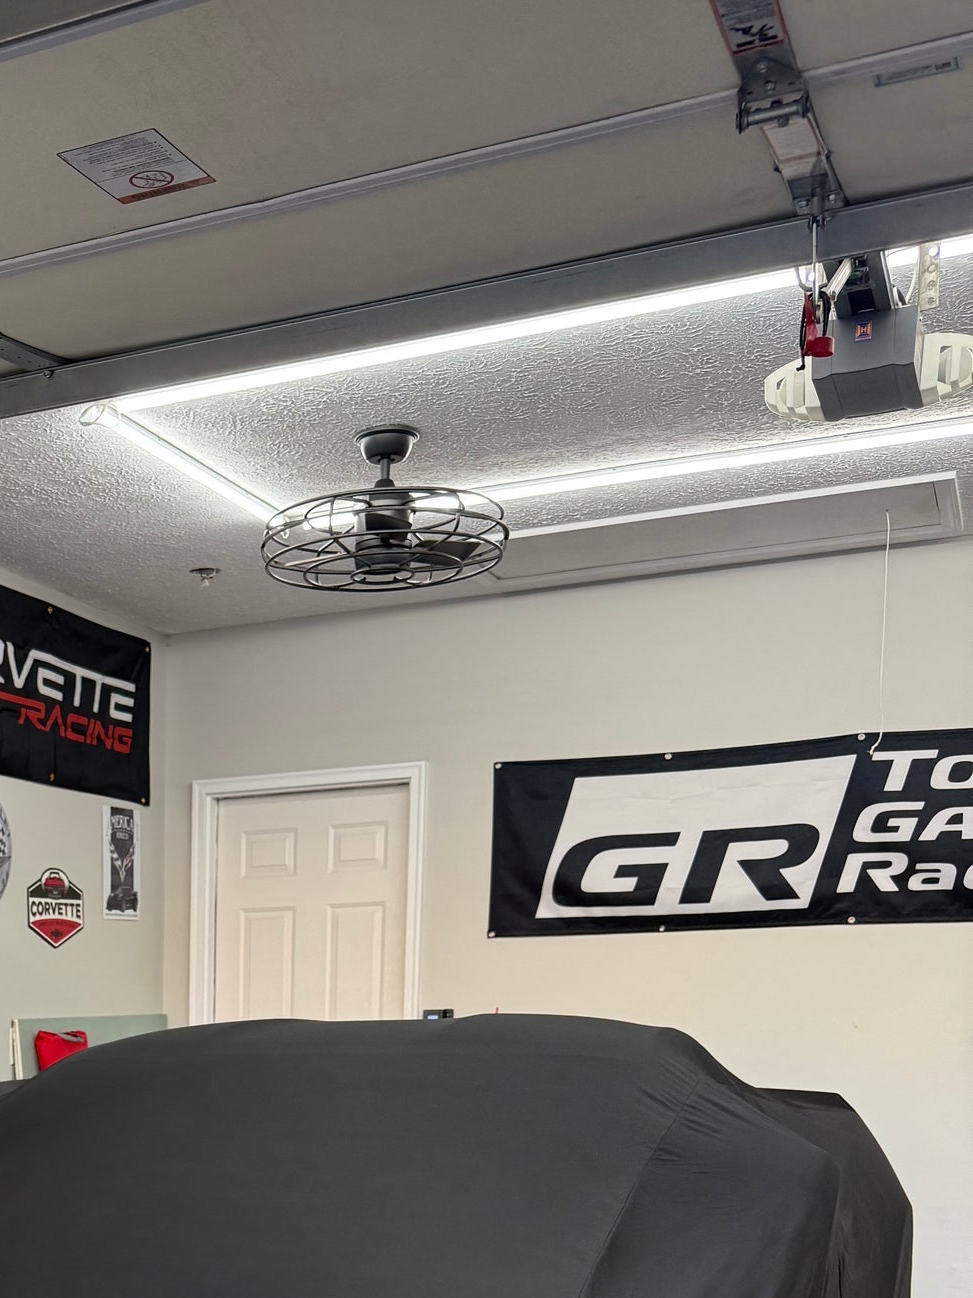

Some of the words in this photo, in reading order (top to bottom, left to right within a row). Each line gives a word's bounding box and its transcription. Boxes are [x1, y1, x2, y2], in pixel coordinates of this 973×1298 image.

[18, 701, 133, 754] RACING
[852, 801, 973, 843] GA
[552, 823, 820, 908] GR
[836, 852, 973, 893] Ra
[31, 901, 81, 919] CORVETTE
